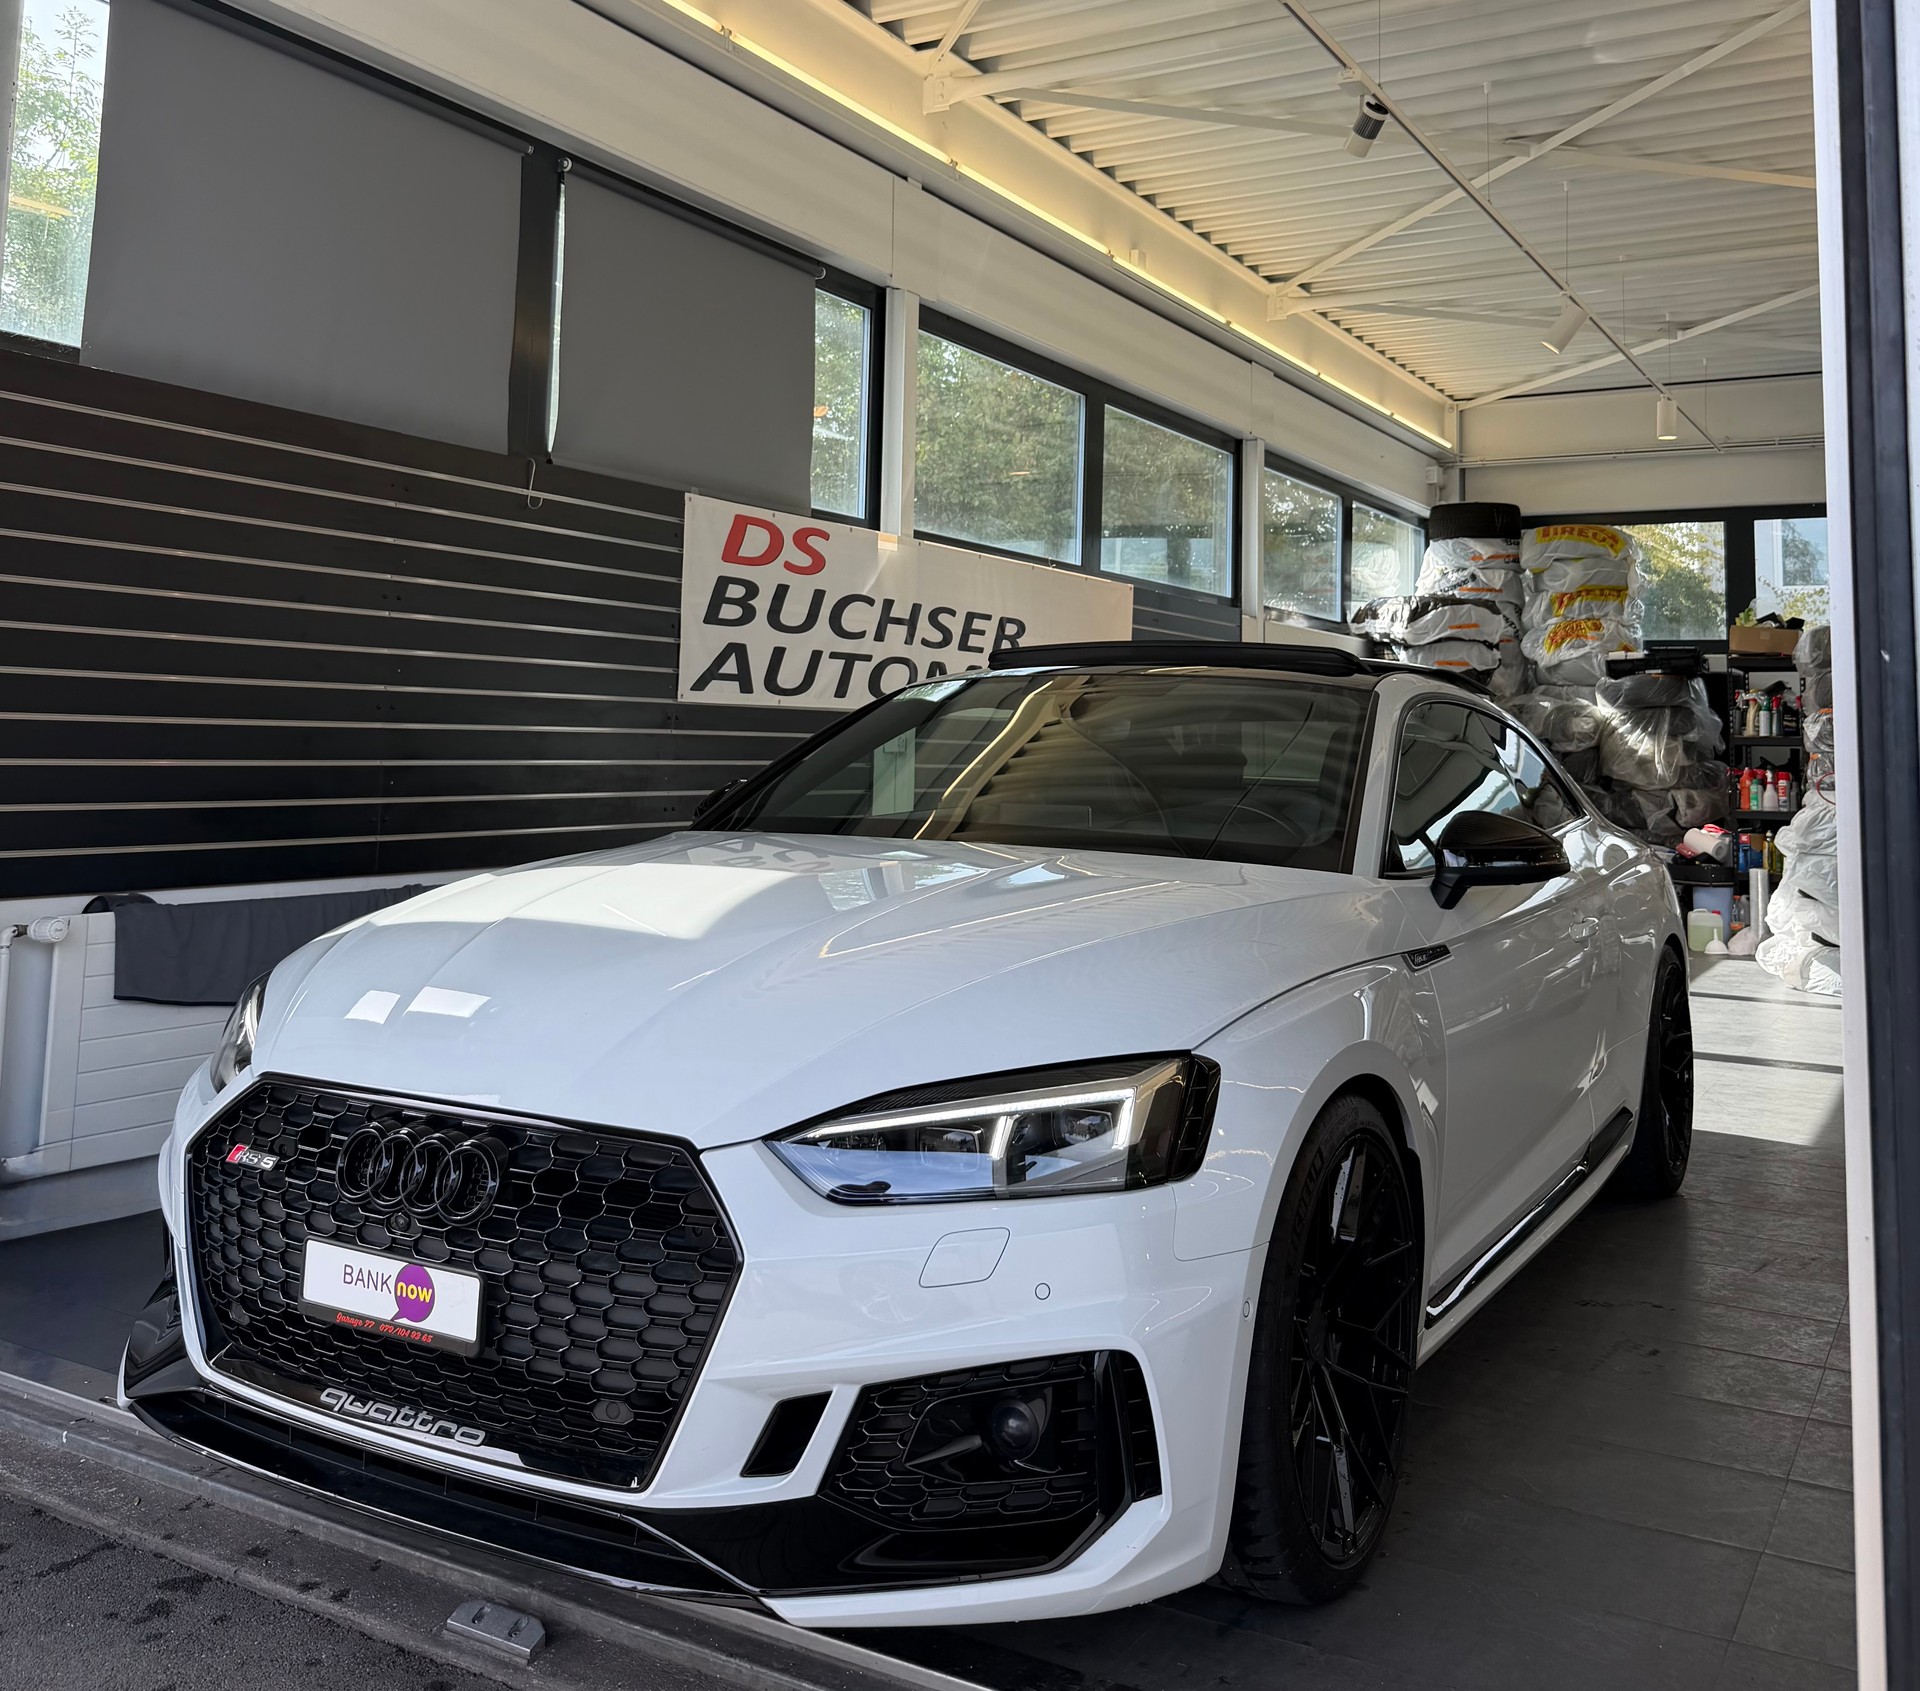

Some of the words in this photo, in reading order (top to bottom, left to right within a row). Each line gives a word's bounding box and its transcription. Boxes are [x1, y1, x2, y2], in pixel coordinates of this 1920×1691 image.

[721, 513, 830, 576] DS
[702, 575, 1027, 654] BUCHSER
[343, 1263, 393, 1296] BANK
[396, 1280, 433, 1304] now
[364, 1319, 376, 1329] 77
[320, 1387, 486, 1446] quattro
